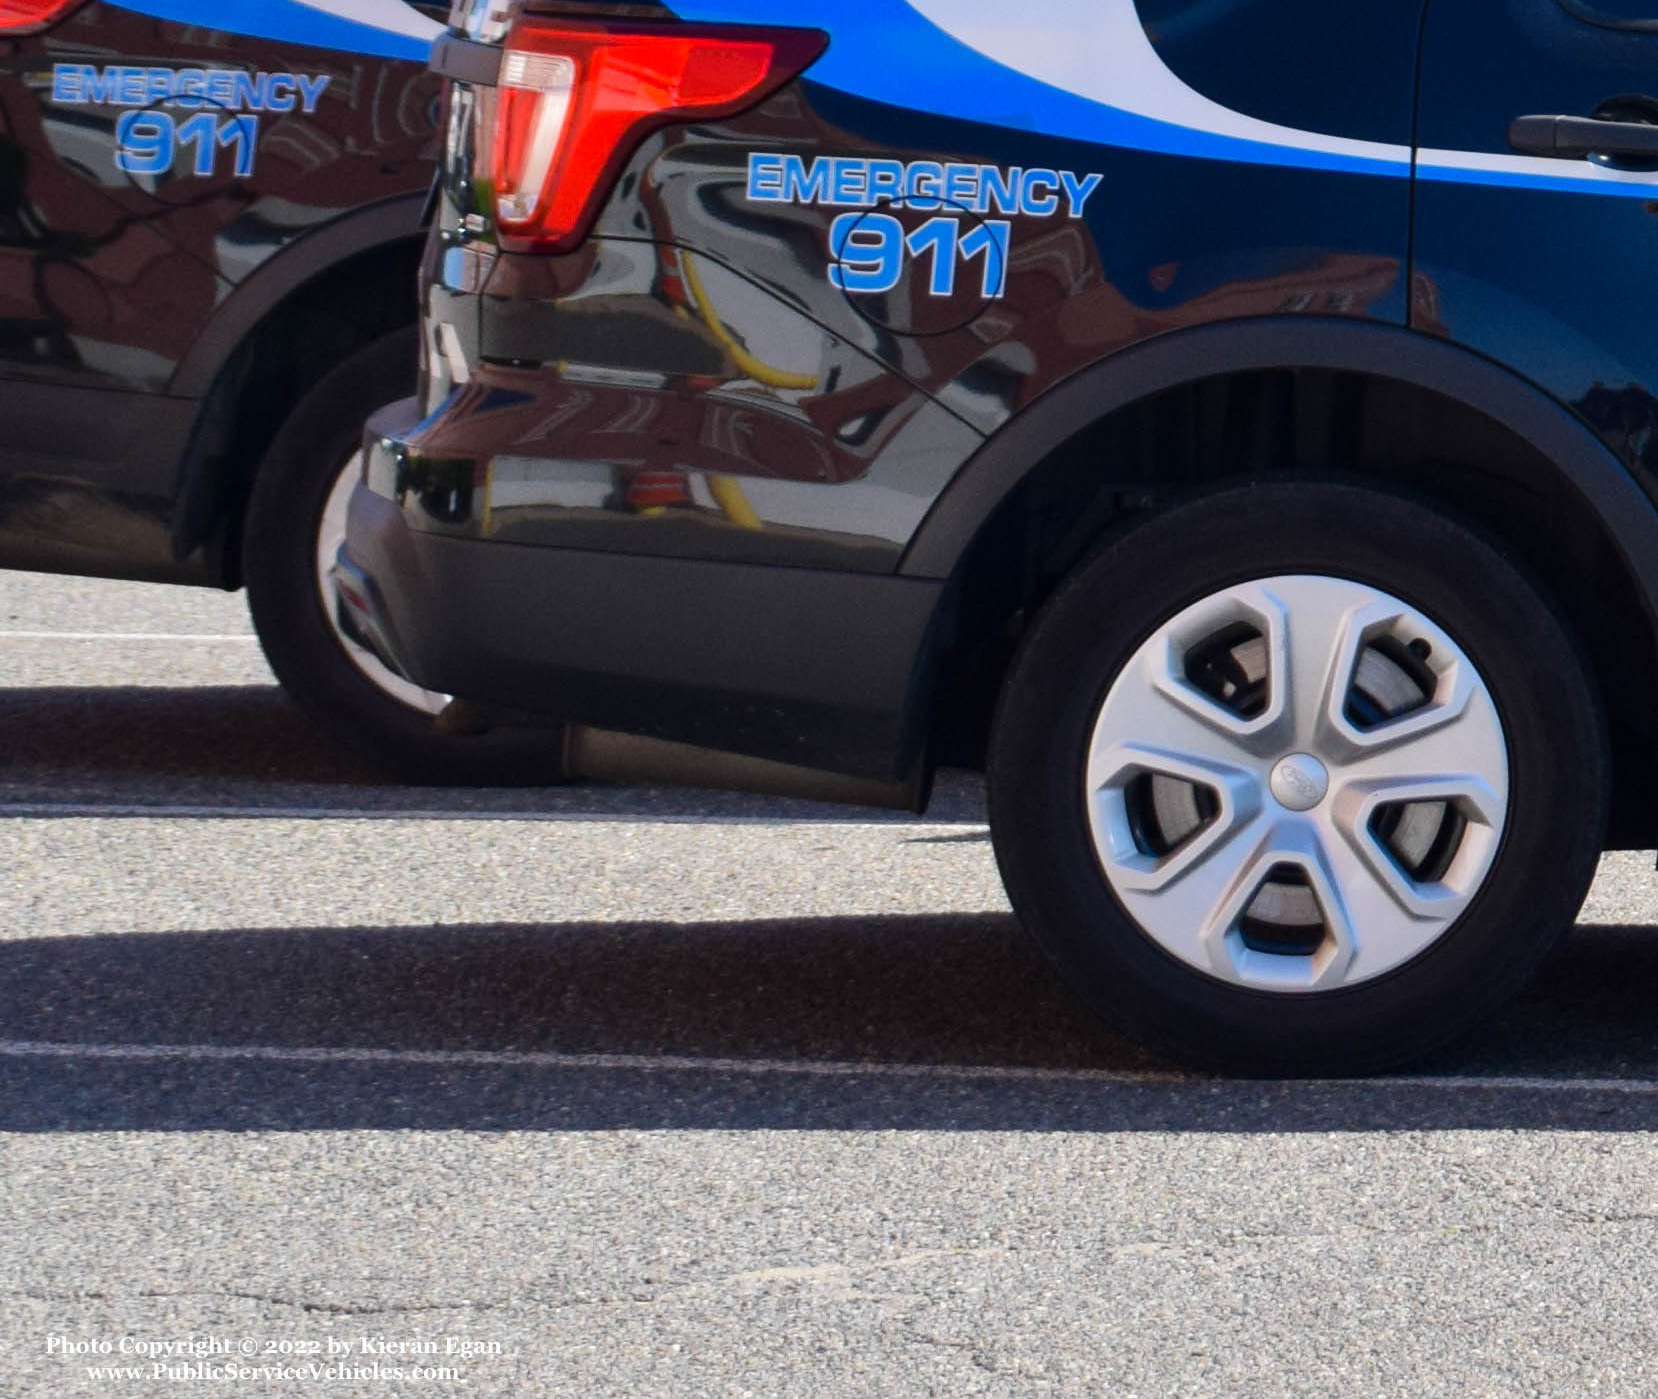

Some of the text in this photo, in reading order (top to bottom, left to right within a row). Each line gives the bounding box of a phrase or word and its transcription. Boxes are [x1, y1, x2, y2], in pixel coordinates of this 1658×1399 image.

[52, 63, 331, 113] EMERGENCY
[114, 109, 259, 178] 911
[746, 152, 1104, 218] EMERGENCY
[827, 211, 1012, 299] 911
